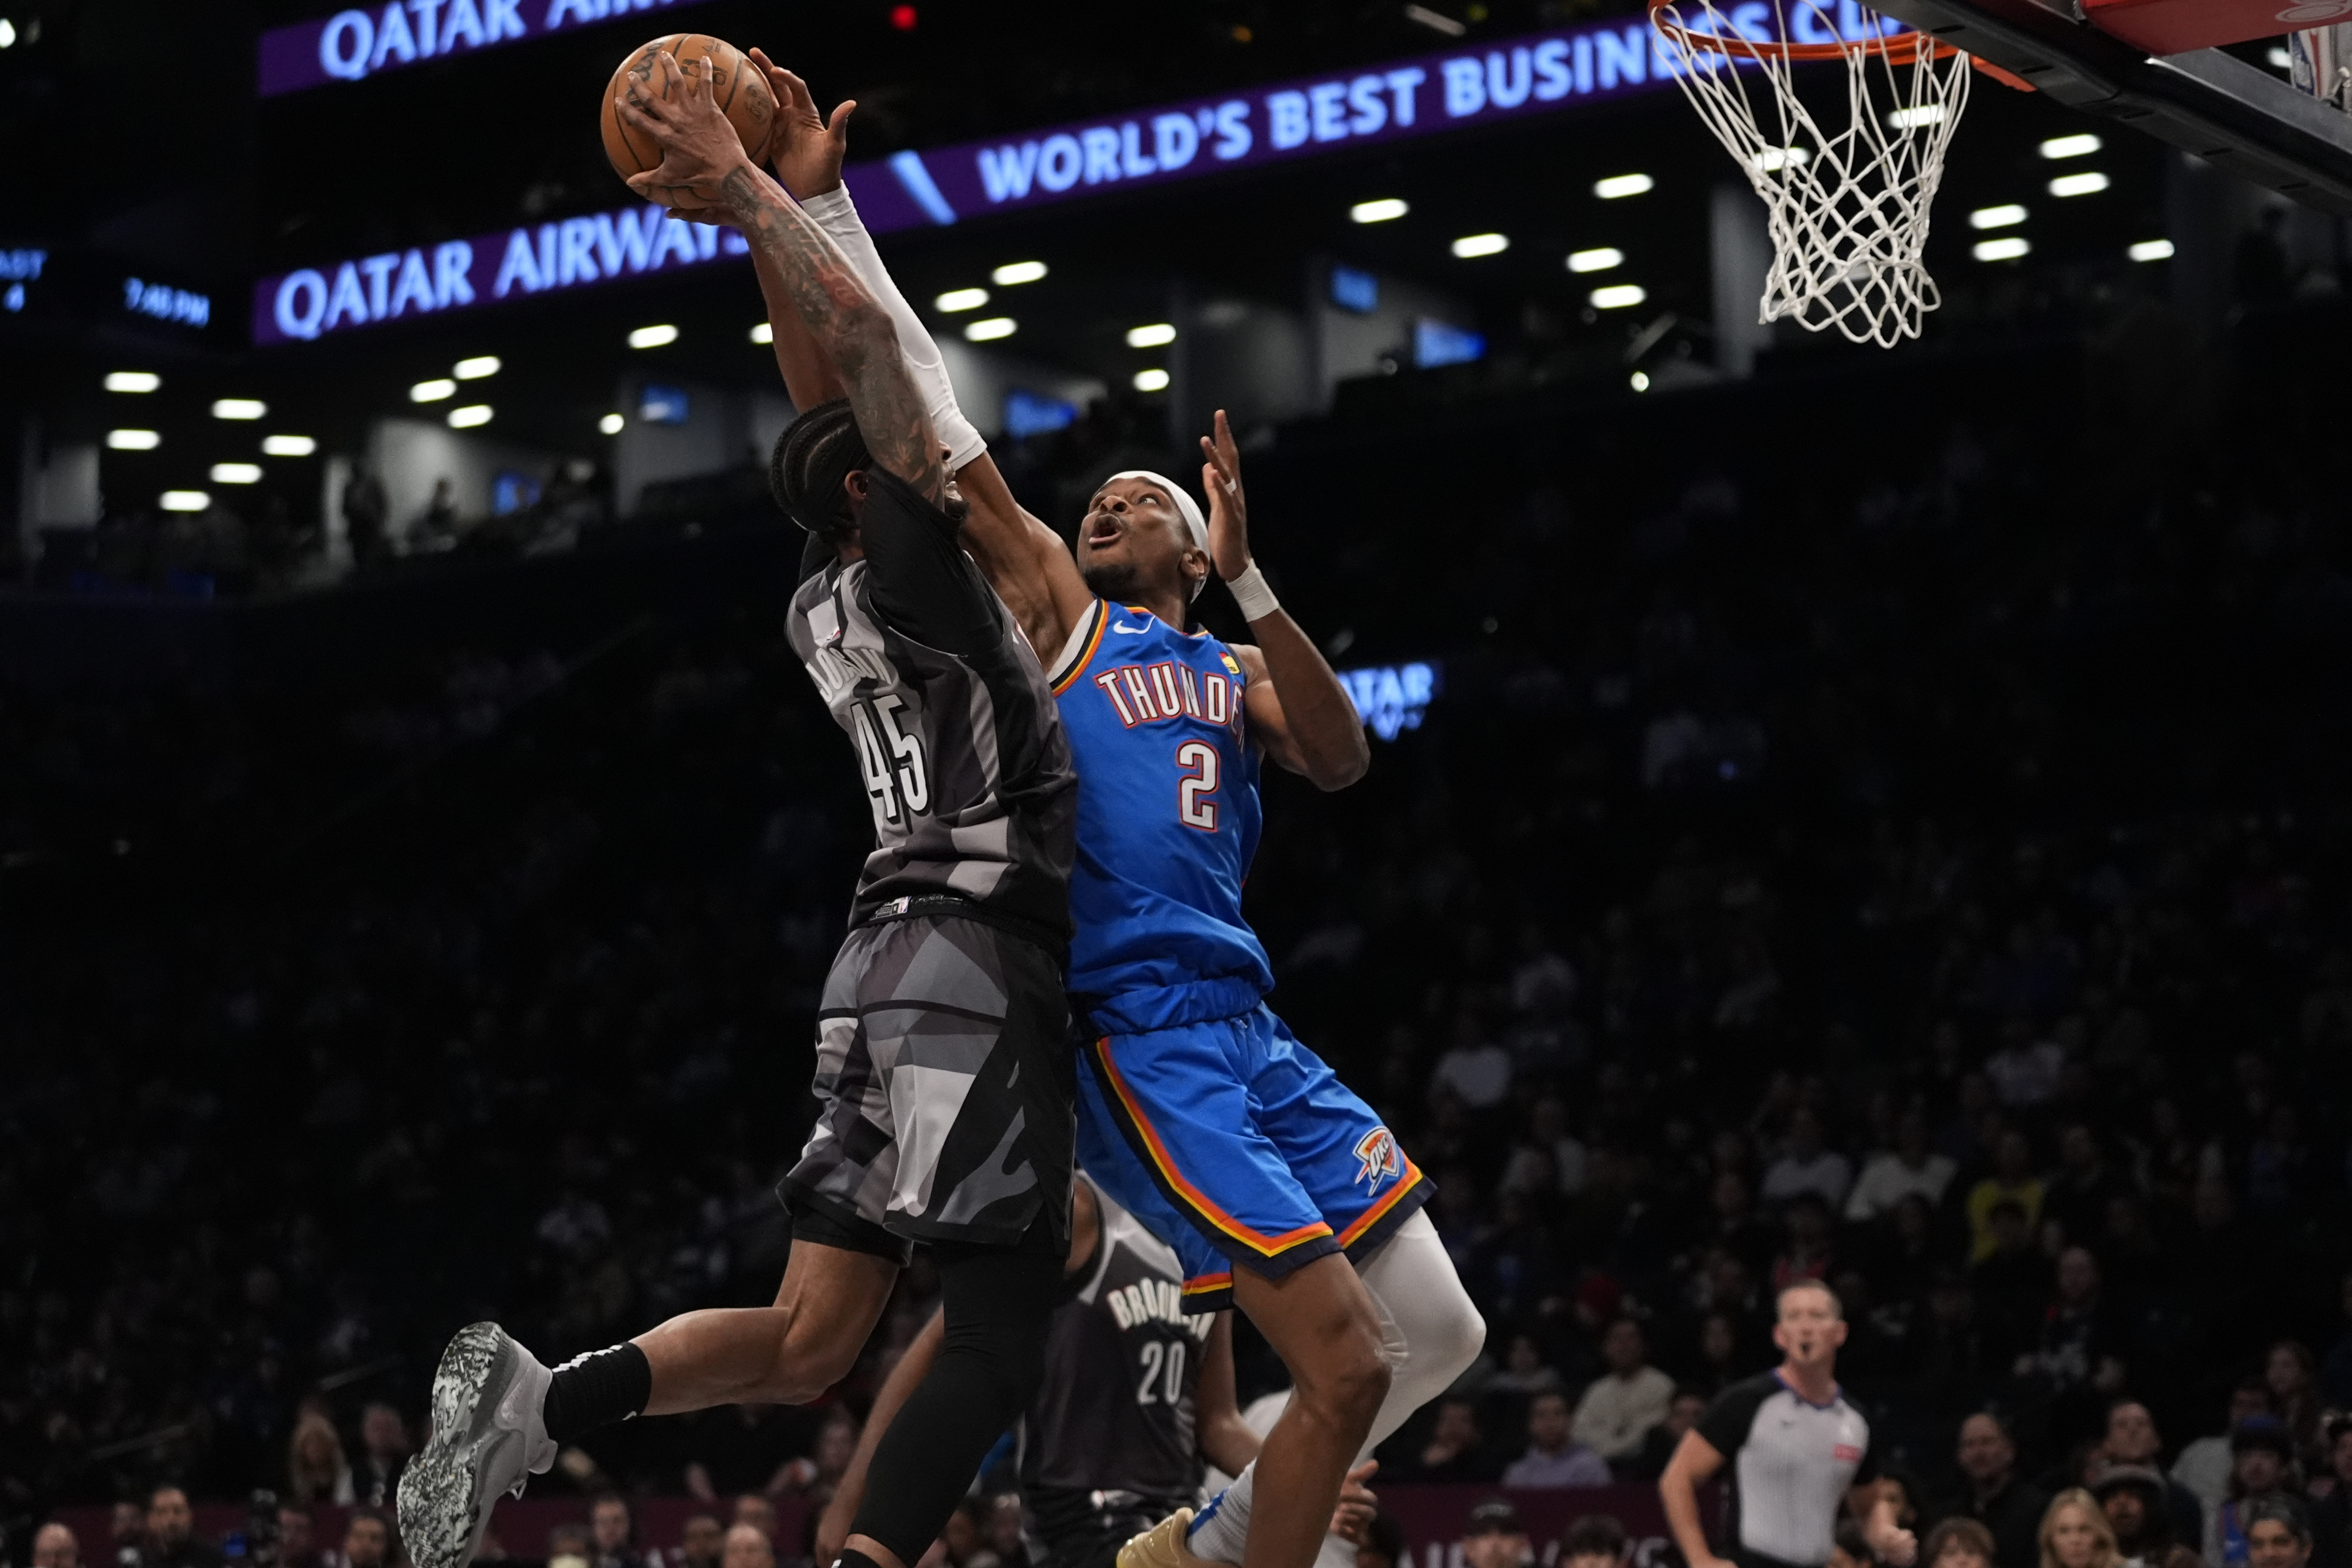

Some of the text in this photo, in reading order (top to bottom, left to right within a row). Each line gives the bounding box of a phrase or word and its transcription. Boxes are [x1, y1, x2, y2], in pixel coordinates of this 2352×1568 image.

[320, 0, 525, 80] QATAR
[978, 101, 1252, 202] WORLD'S
[1267, 68, 1426, 150] BEST
[1442, 2, 1773, 117] BUSINESS
[274, 241, 475, 340] QATAR
[1093, 660, 1245, 754] THUNDE
[851, 694, 928, 819] 45
[1177, 740, 1219, 832] 2
[1137, 1339, 1186, 1406] 20
